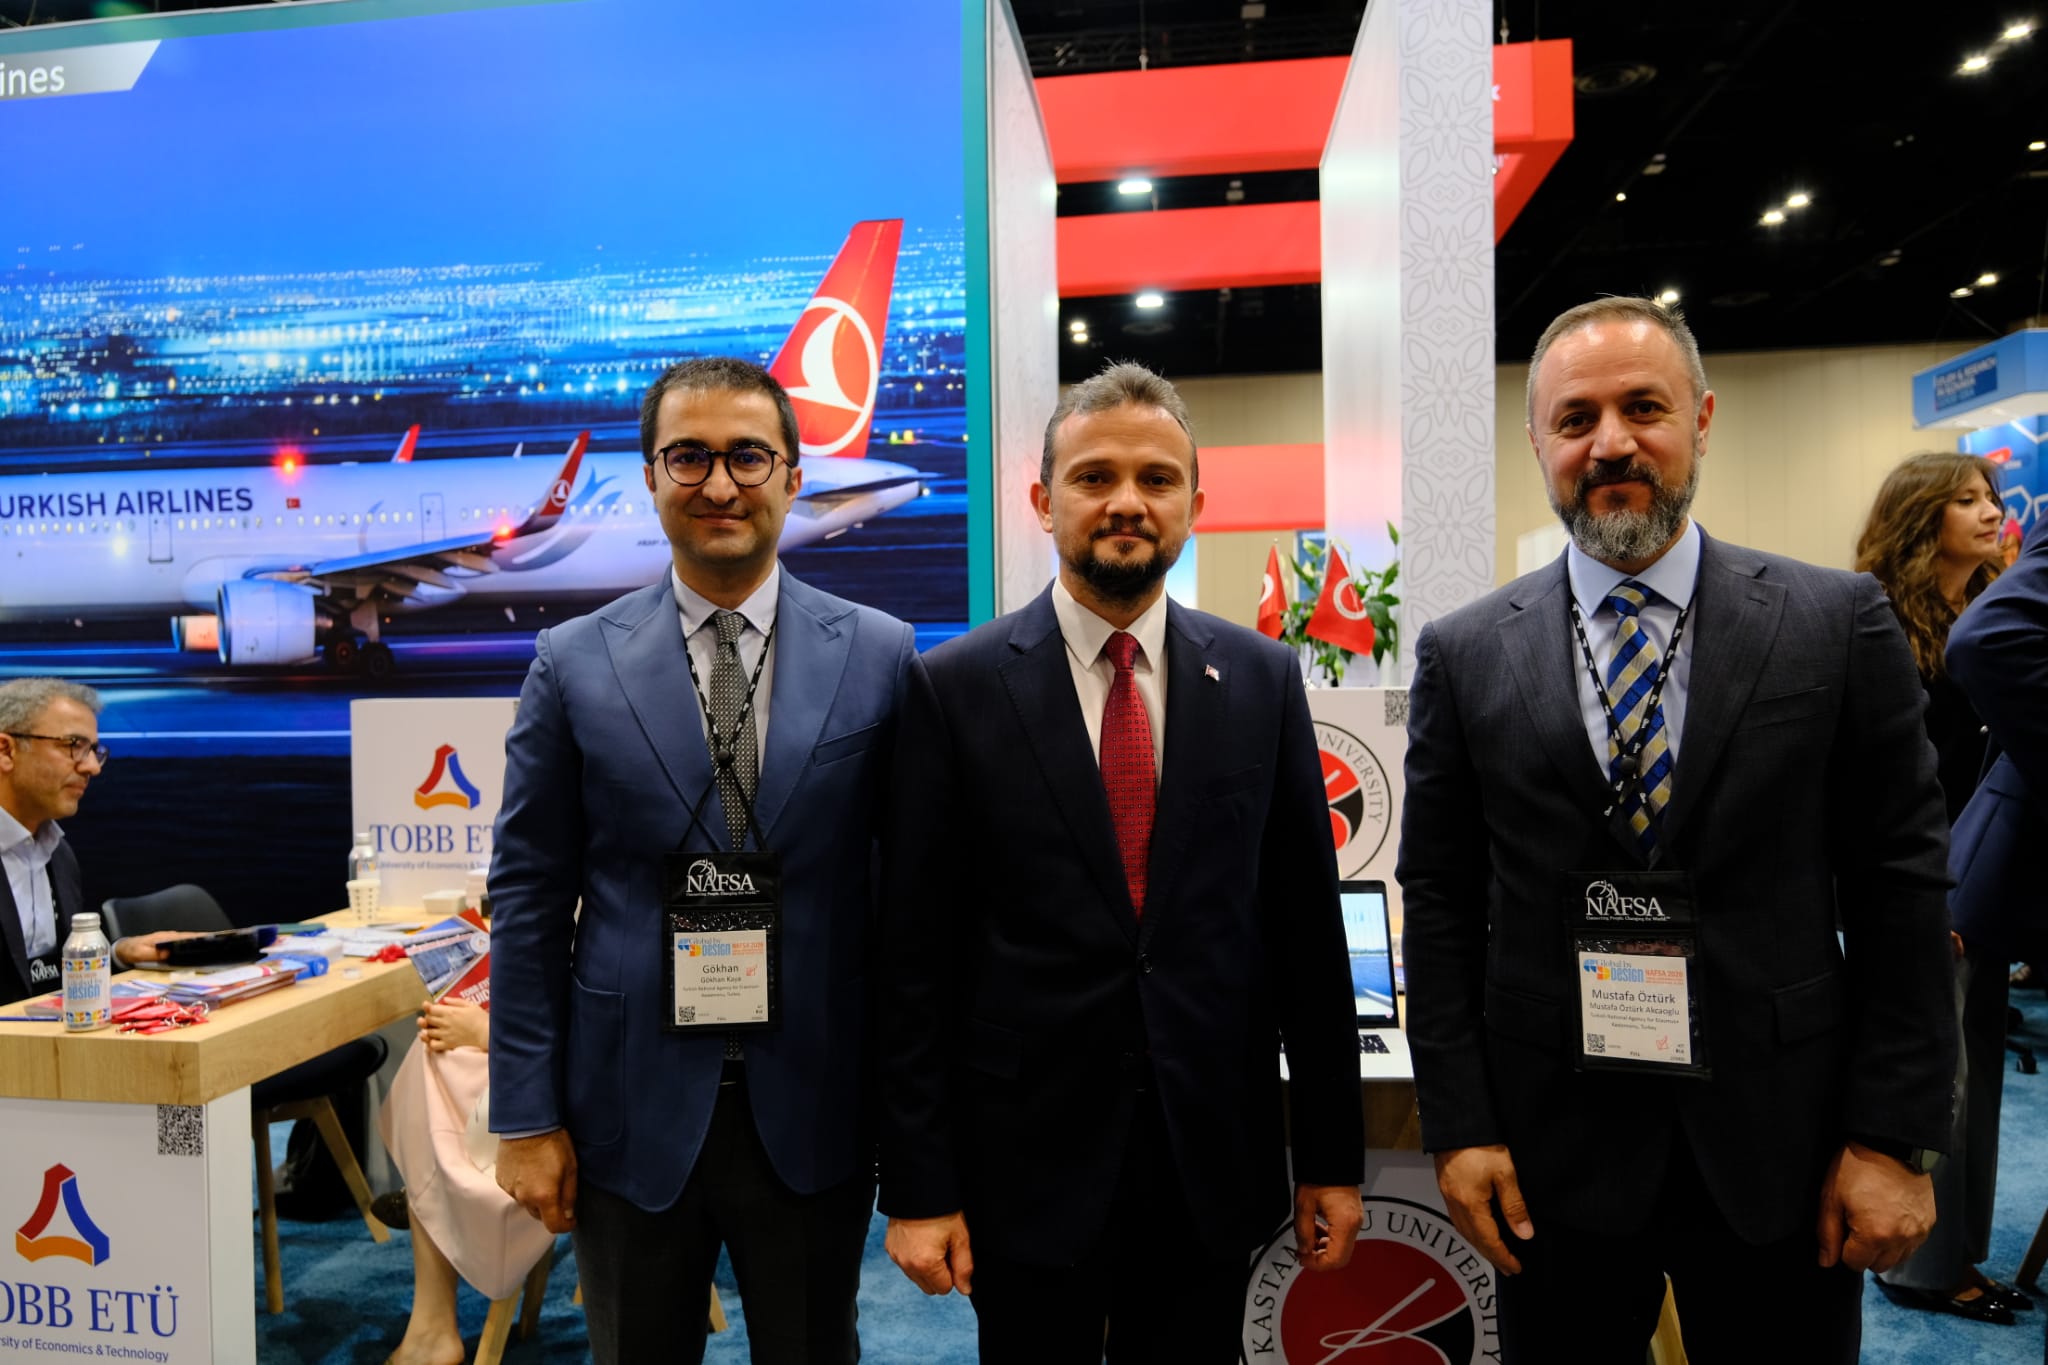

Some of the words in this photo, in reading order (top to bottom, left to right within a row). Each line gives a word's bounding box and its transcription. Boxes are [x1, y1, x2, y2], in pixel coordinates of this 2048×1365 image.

[116, 487, 254, 515] AIRLINES
[369, 824, 454, 853] TOBB
[686, 873, 755, 892] NAFSA
[1584, 896, 1666, 916] NAFSA
[702, 964, 739, 974] Gökhan
[1592, 989, 1635, 1001] Mustafa
[1638, 991, 1676, 1004] Öztürk
[1590, 1002, 1618, 1011] Mustafa
[1620, 1004, 1643, 1013] Öztürk
[87, 1285, 179, 1337] ETÜ
[22, 1337, 33, 1349] of
[35, 1338, 94, 1356] Economics
[95, 1344, 104, 1356] &
[104, 1344, 169, 1364] Technology
